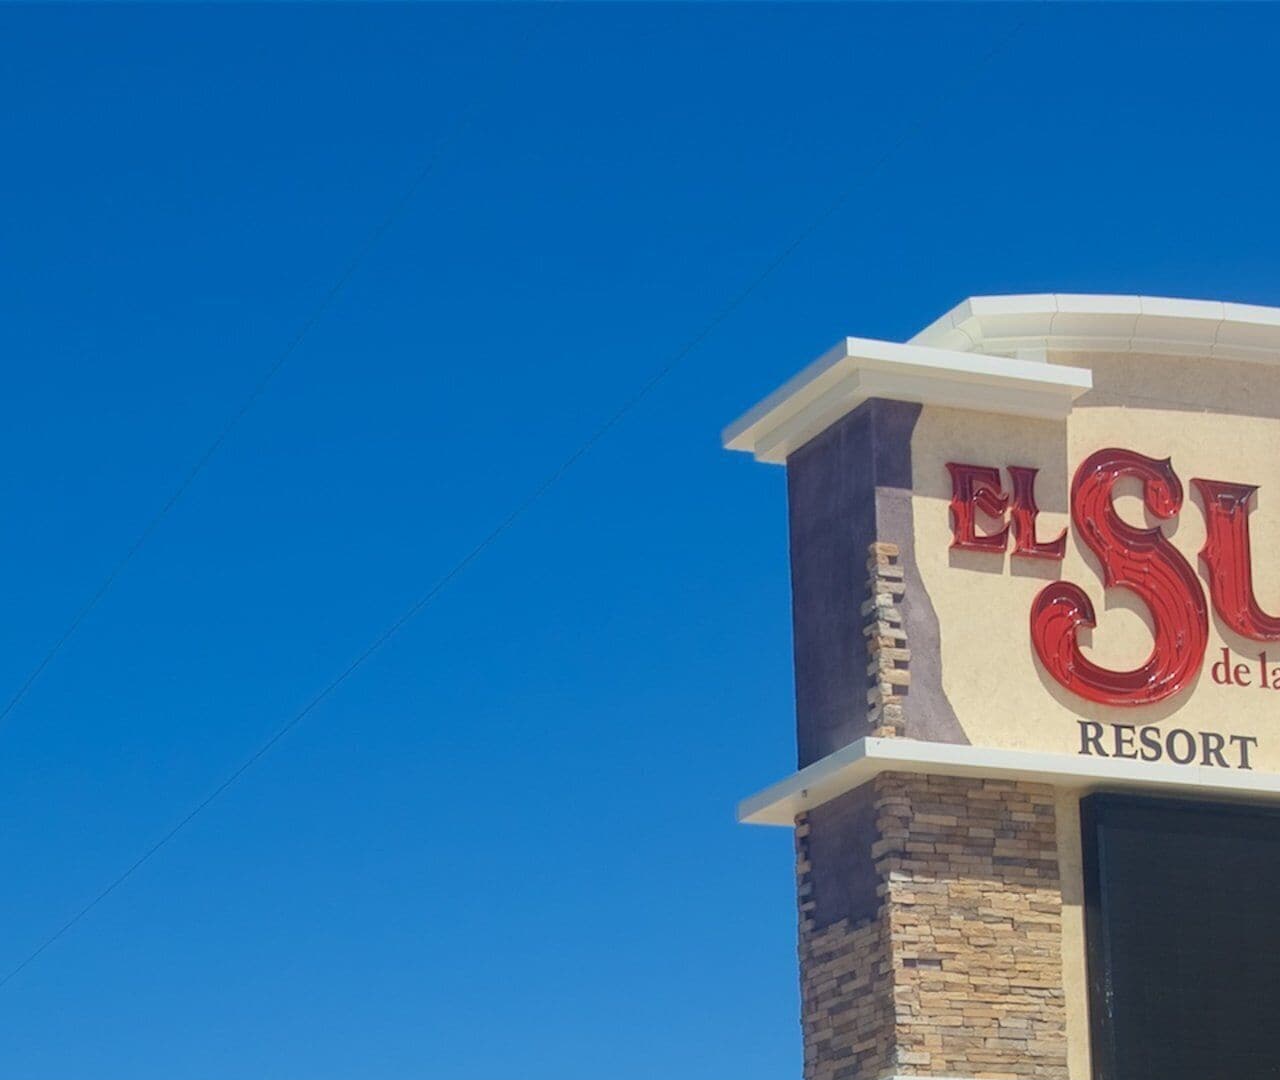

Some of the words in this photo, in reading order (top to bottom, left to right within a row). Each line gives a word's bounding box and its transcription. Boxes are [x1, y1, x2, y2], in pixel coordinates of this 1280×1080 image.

[945, 461, 1067, 560] EL
[1211, 647, 1252, 687] de
[1076, 720, 1259, 770] RESORT
